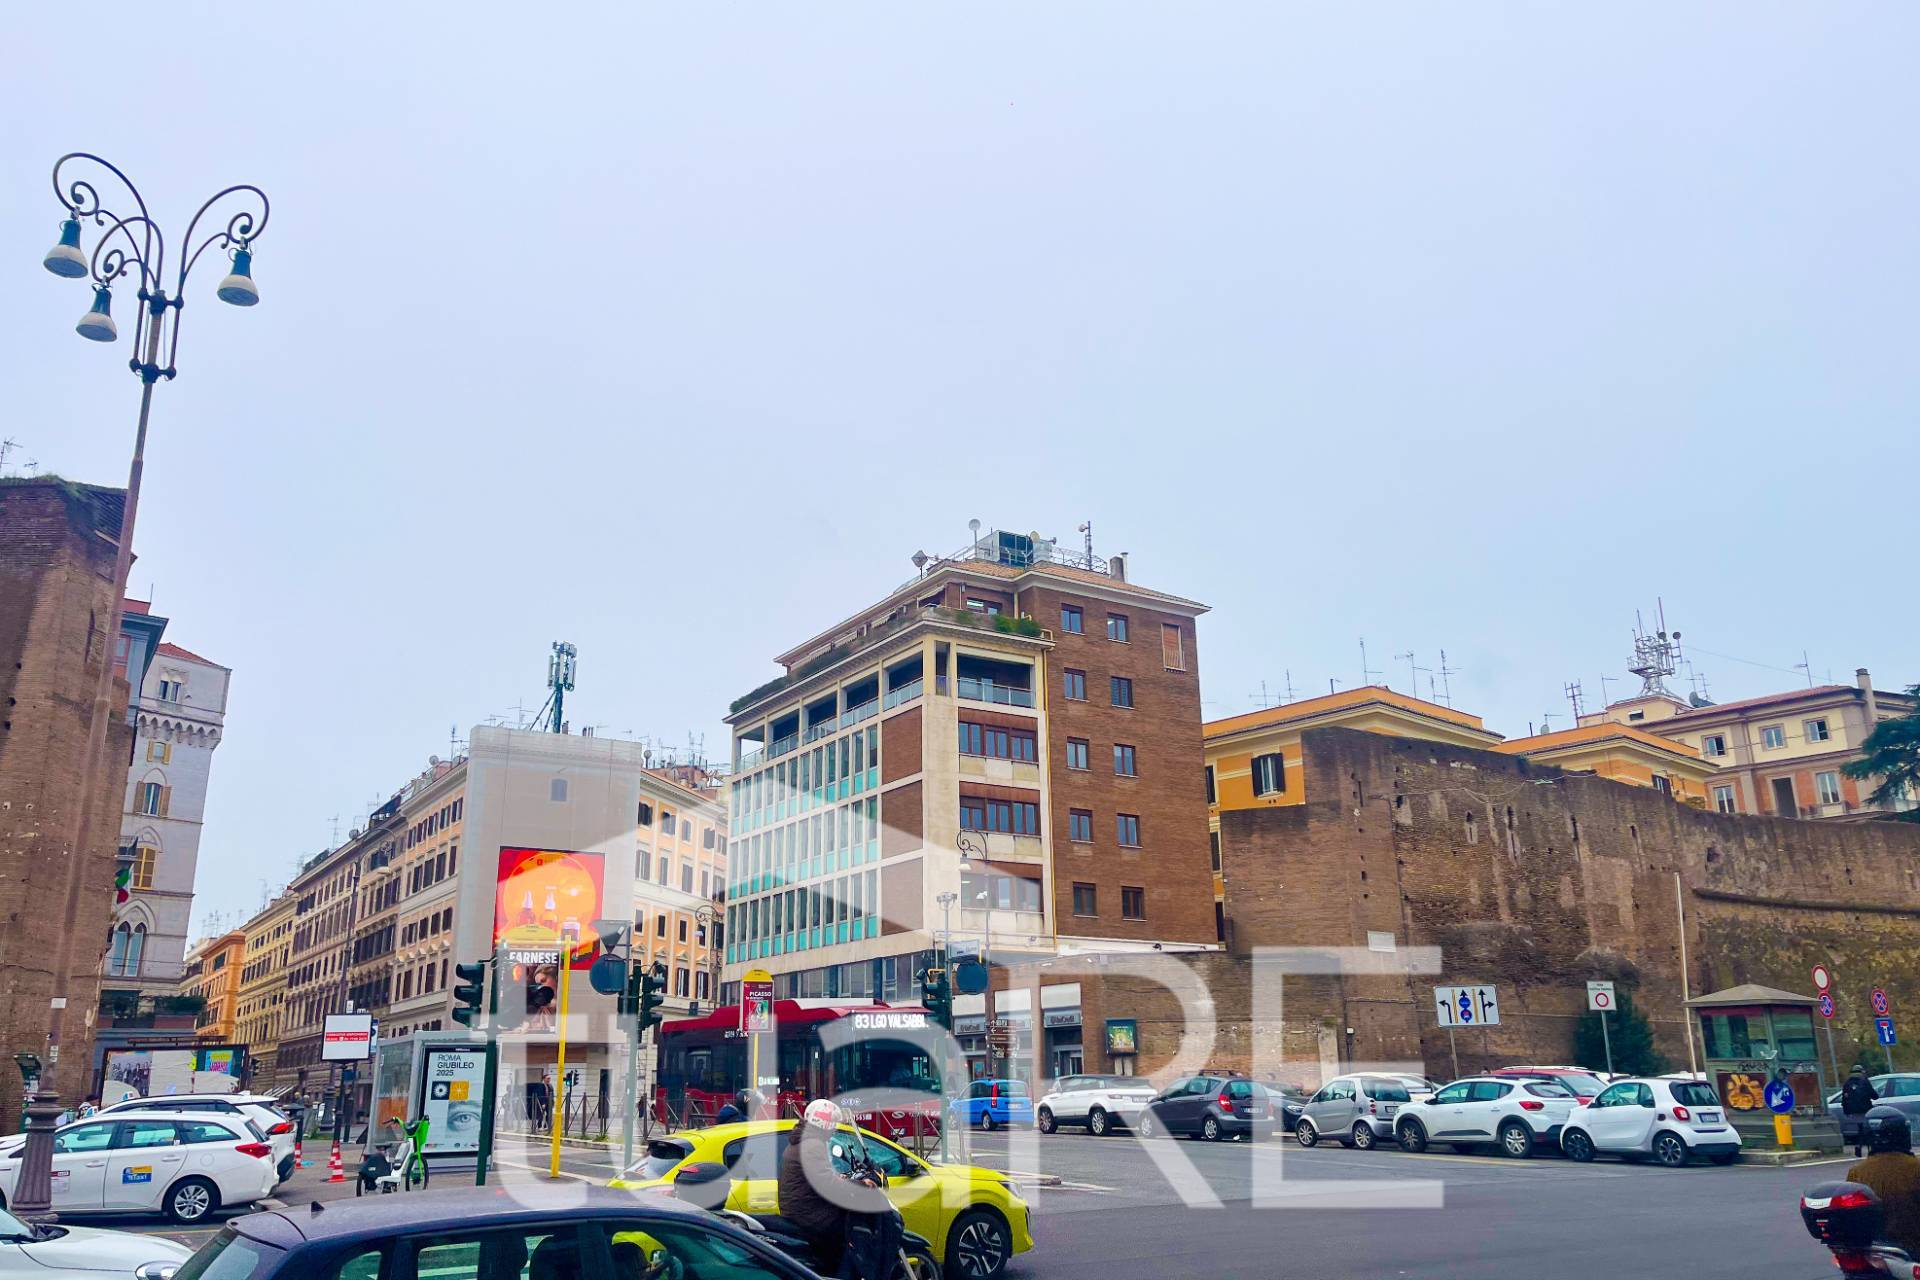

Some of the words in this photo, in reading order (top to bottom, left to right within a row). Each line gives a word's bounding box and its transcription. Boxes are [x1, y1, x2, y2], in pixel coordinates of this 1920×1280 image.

[855, 1013, 870, 1029] 83
[438, 1053, 461, 1061] ROMA
[437, 1061, 475, 1069] GIUBILEO
[436, 1069, 454, 1077] 2025
